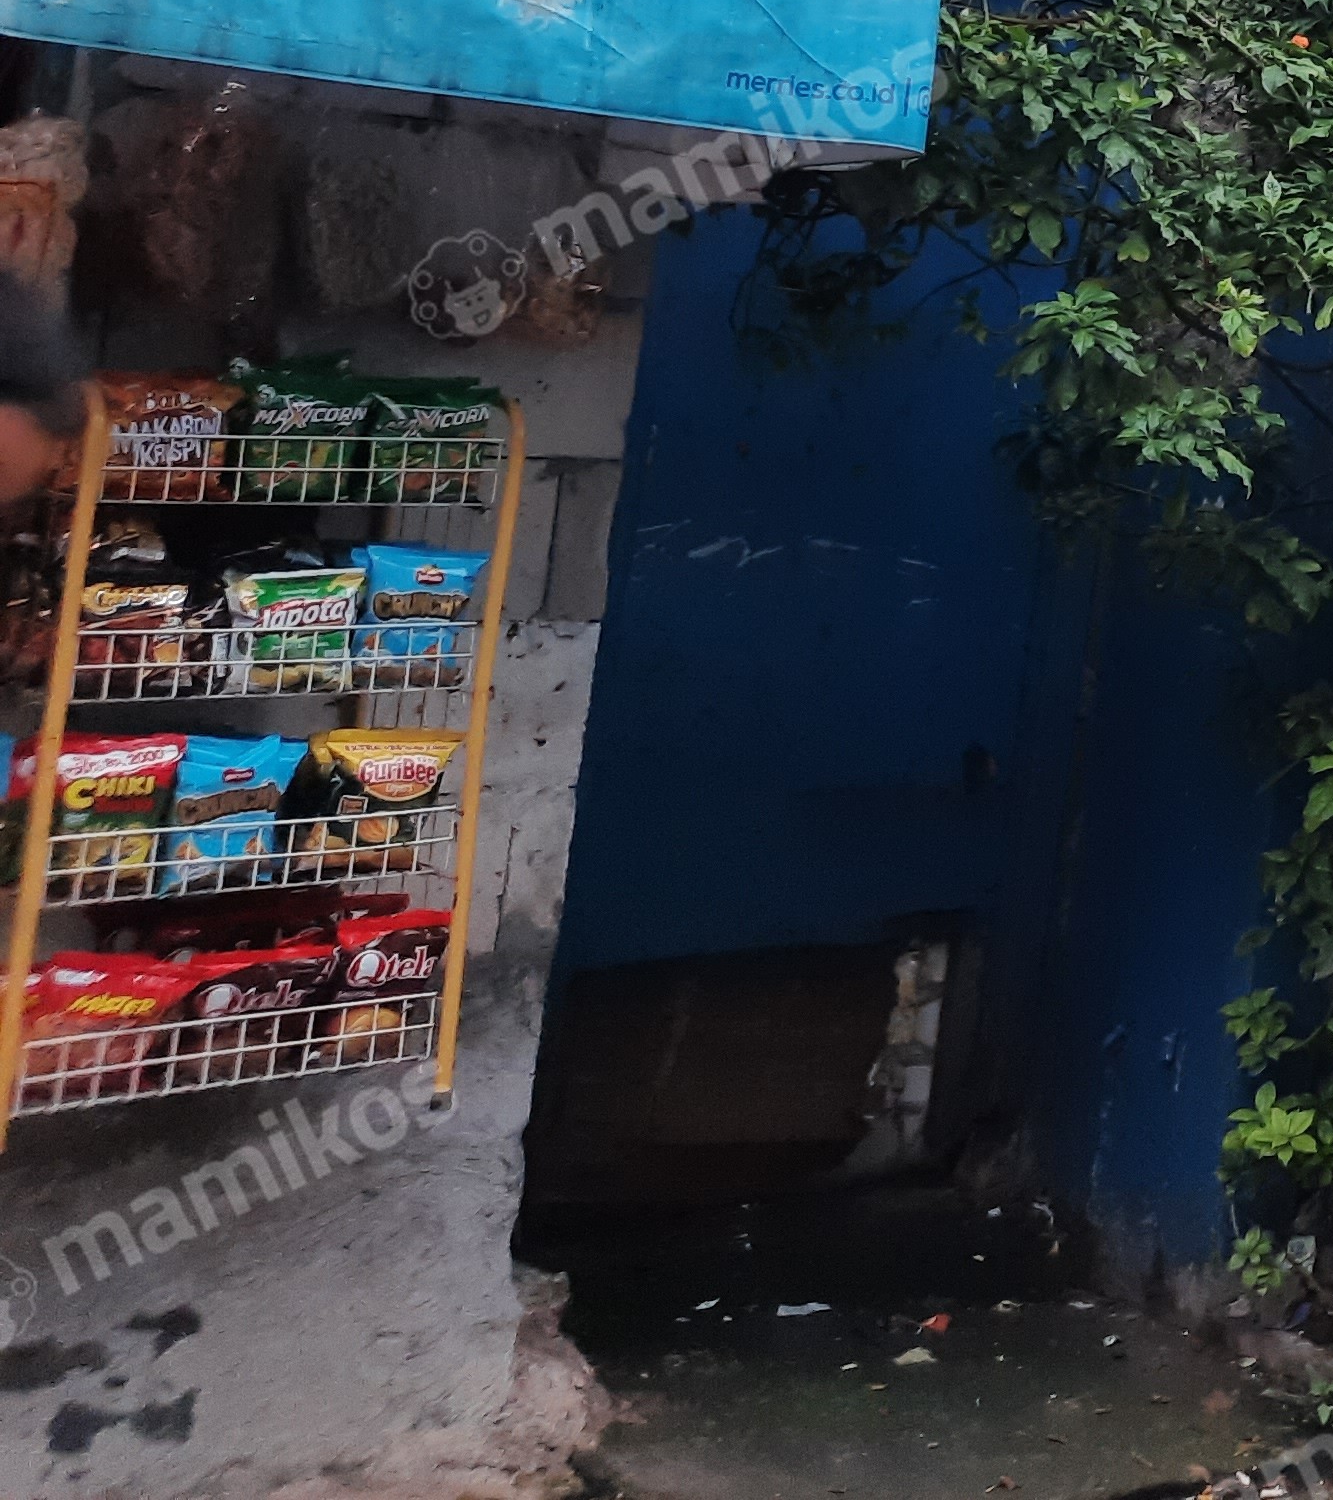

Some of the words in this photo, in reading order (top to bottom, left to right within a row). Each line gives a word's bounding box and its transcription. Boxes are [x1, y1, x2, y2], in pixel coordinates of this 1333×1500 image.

[726, 71, 896, 104] merries.co.id
[252, 399, 368, 436] MAXICORN
[347, 945, 440, 987] Qtela
